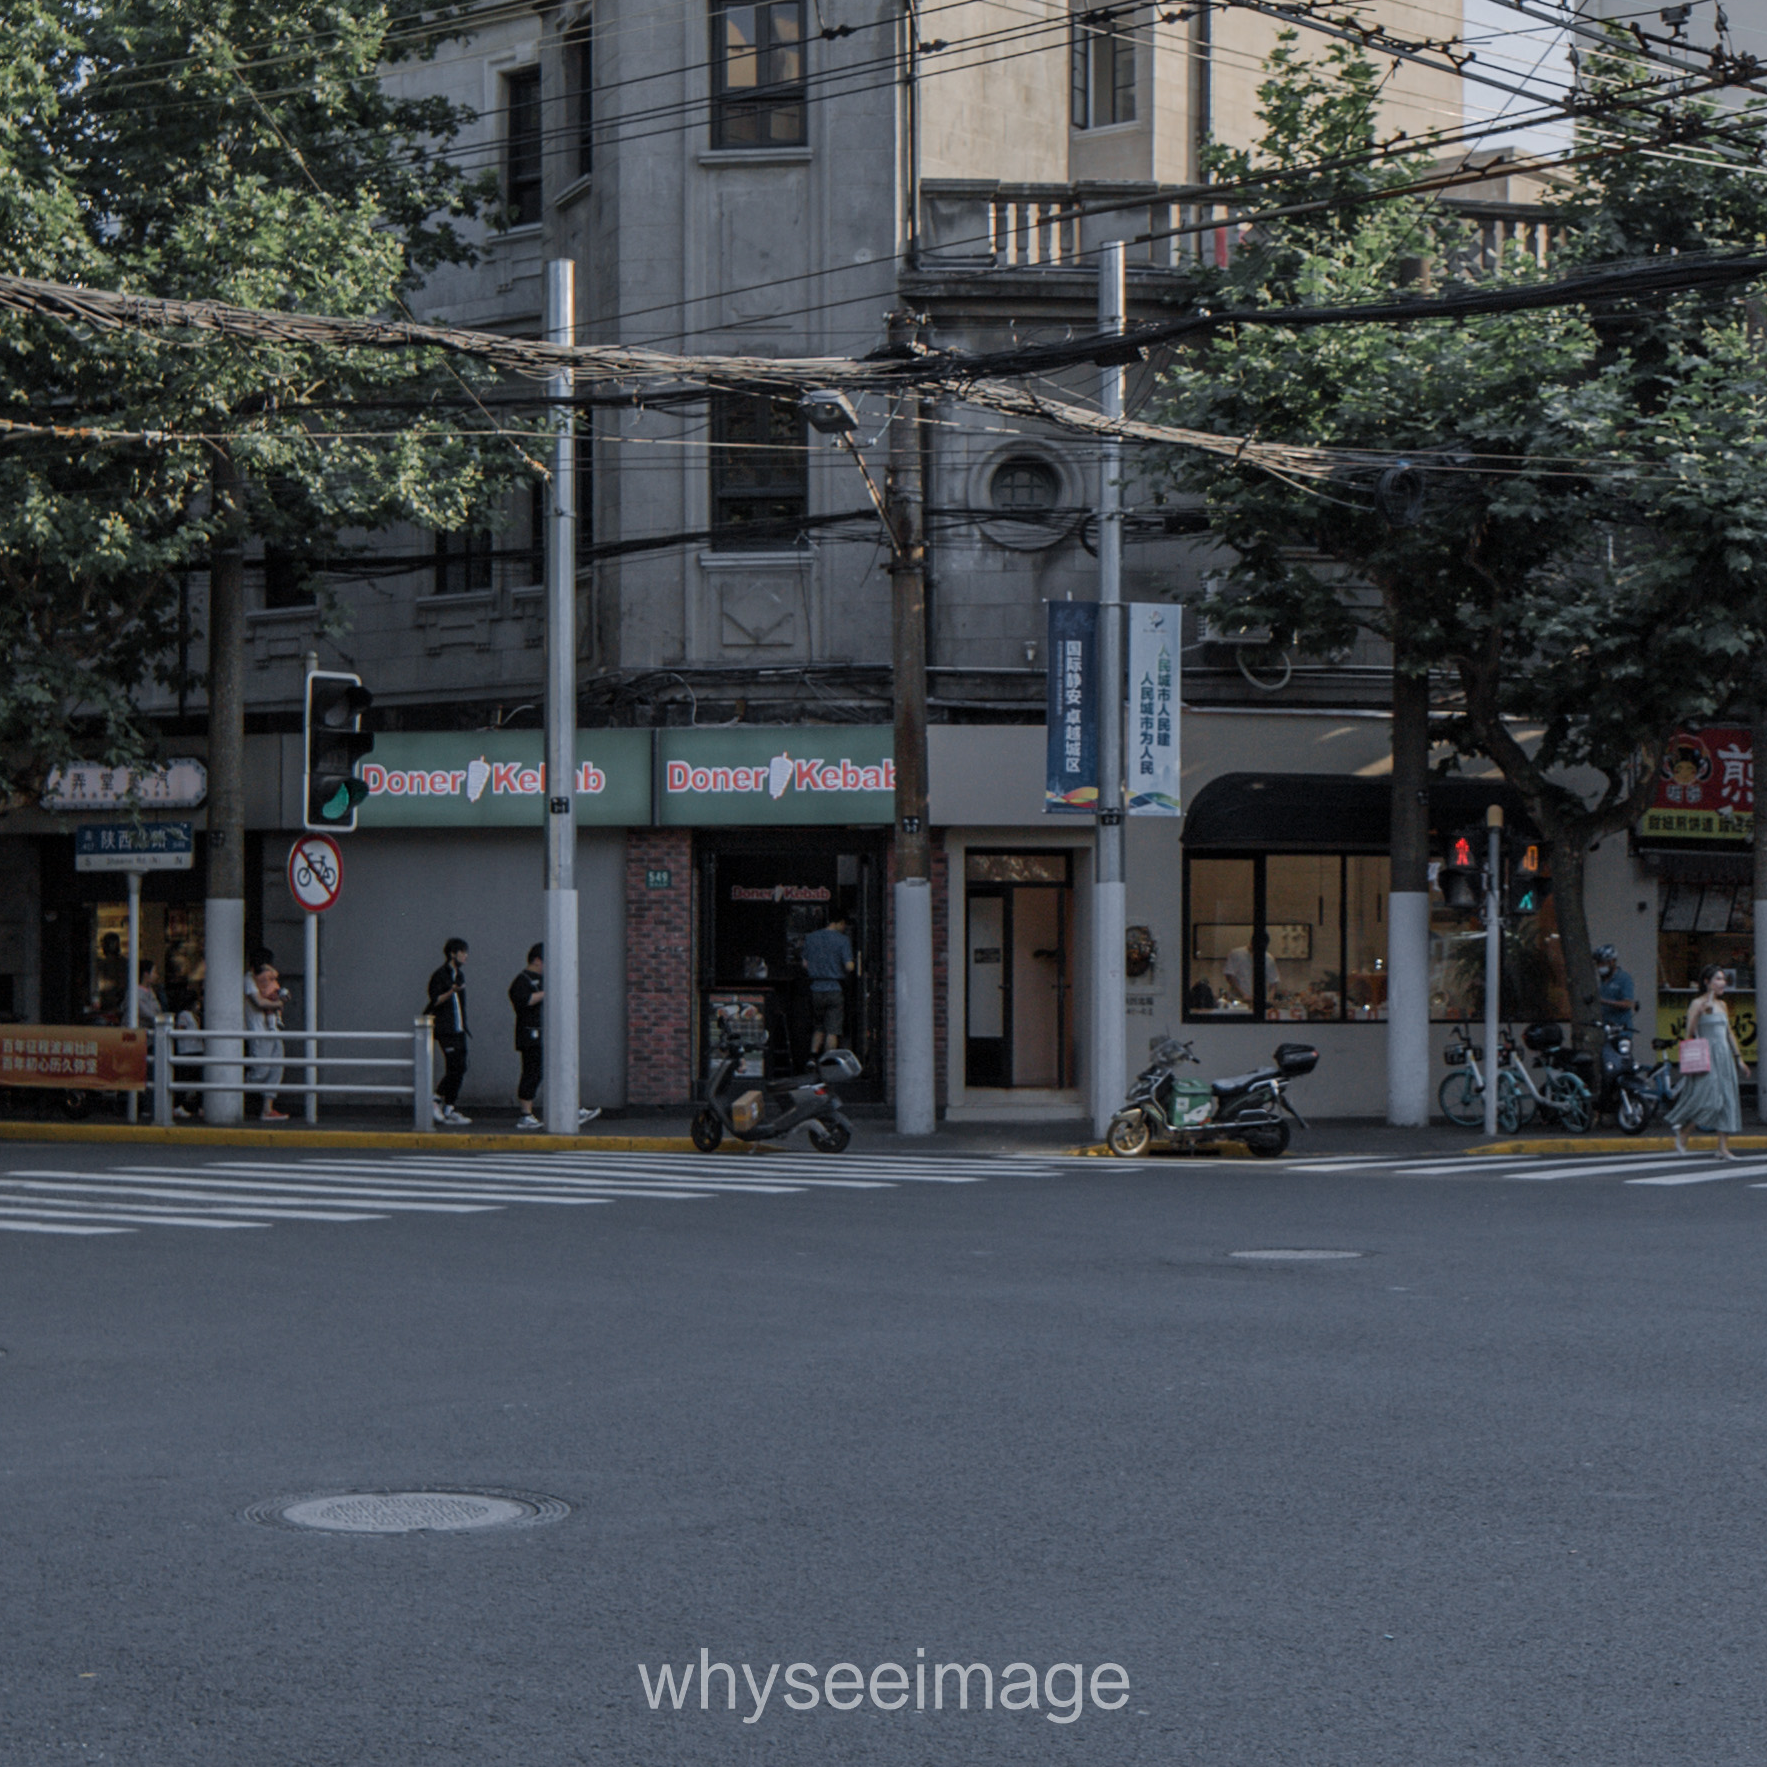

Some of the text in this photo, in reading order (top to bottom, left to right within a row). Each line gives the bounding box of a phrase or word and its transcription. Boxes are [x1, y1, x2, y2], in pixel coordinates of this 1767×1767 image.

[1065, 640, 1082, 773] 国际静安 卓越城区
[1157, 644, 1171, 747] 人民城市人民建
[1140, 671, 1154, 775] 人民城市为人民
[362, 762, 606, 795] Doner Keb
[667, 760, 769, 793] Doner
[649, 871, 669, 883] 549
[731, 884, 832, 902] Doner Kebab
[2, 1038, 99, 1057] 百年征程波澜壮阔
[2, 1056, 98, 1075] 百年初心历久弥坚
